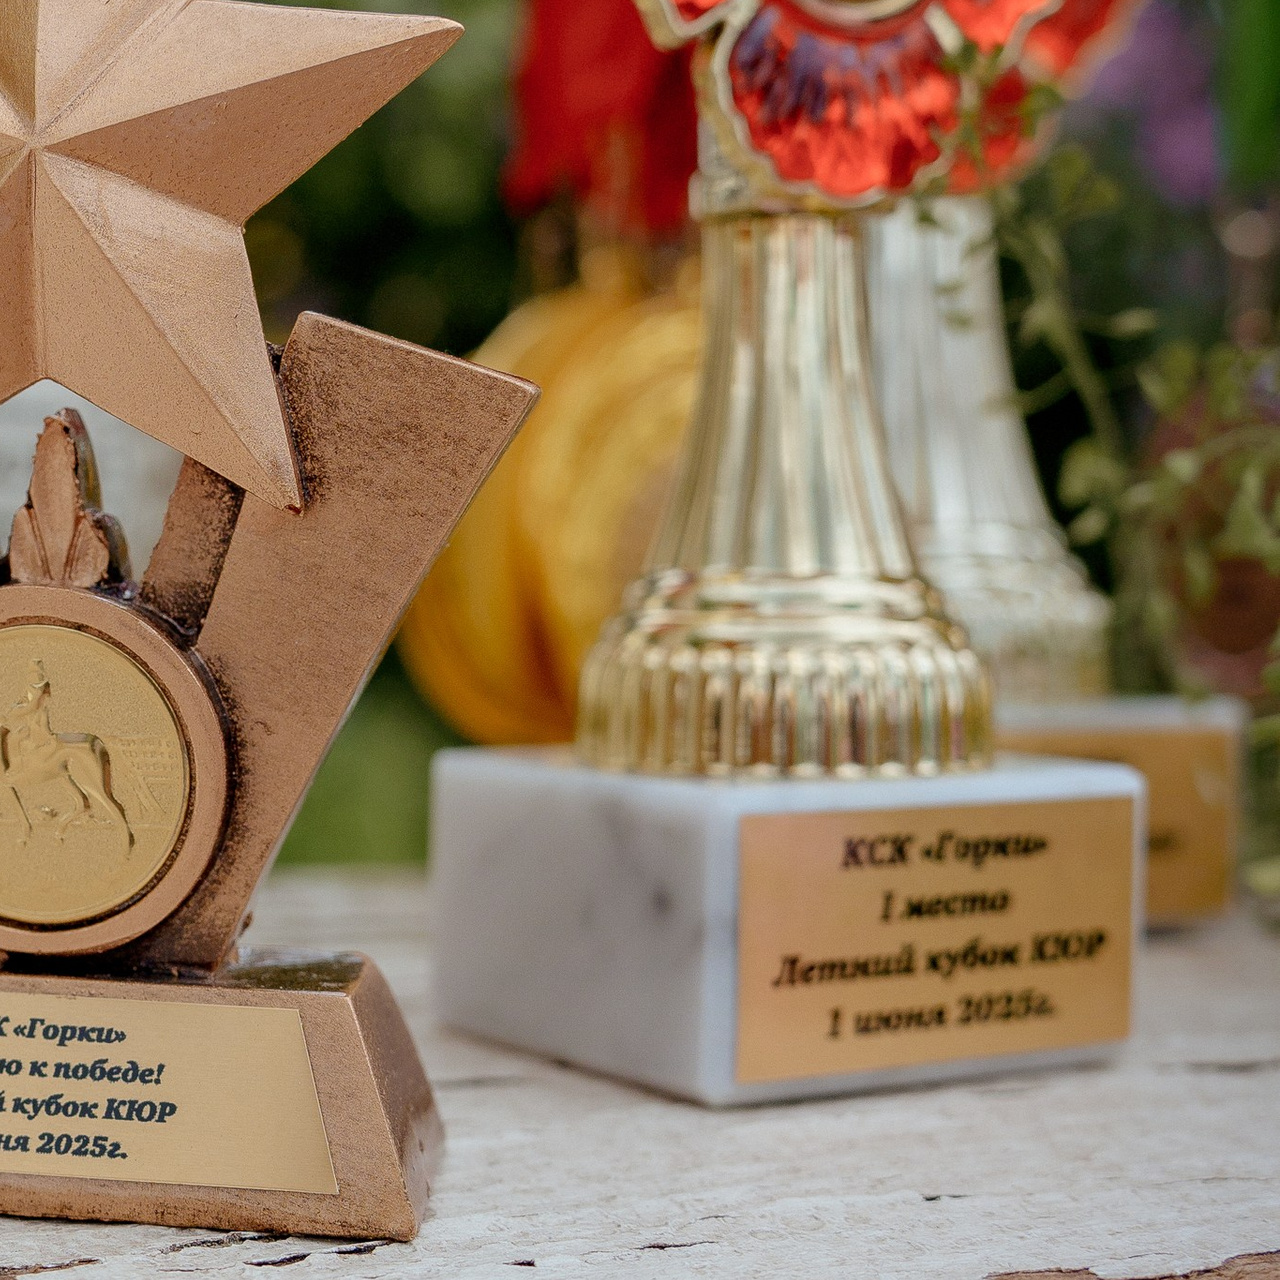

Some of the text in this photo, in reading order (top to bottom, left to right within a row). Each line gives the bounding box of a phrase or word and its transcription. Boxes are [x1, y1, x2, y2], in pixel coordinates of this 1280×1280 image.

[840, 834, 915, 868] КСК
[903, 888, 1011, 919] место
[771, 943, 916, 988] Летний
[925, 937, 1020, 979] кубок
[13, 1018, 127, 1047] «Горки»
[827, 1006, 842, 1039] 1
[855, 1006, 948, 1036] июня
[29, 1060, 48, 1078] к
[53, 1059, 166, 1085] победе!
[12, 1093, 98, 1120] кубок
[102, 1098, 178, 1123] КЮР
[36, 1132, 129, 1159] 2025г.
